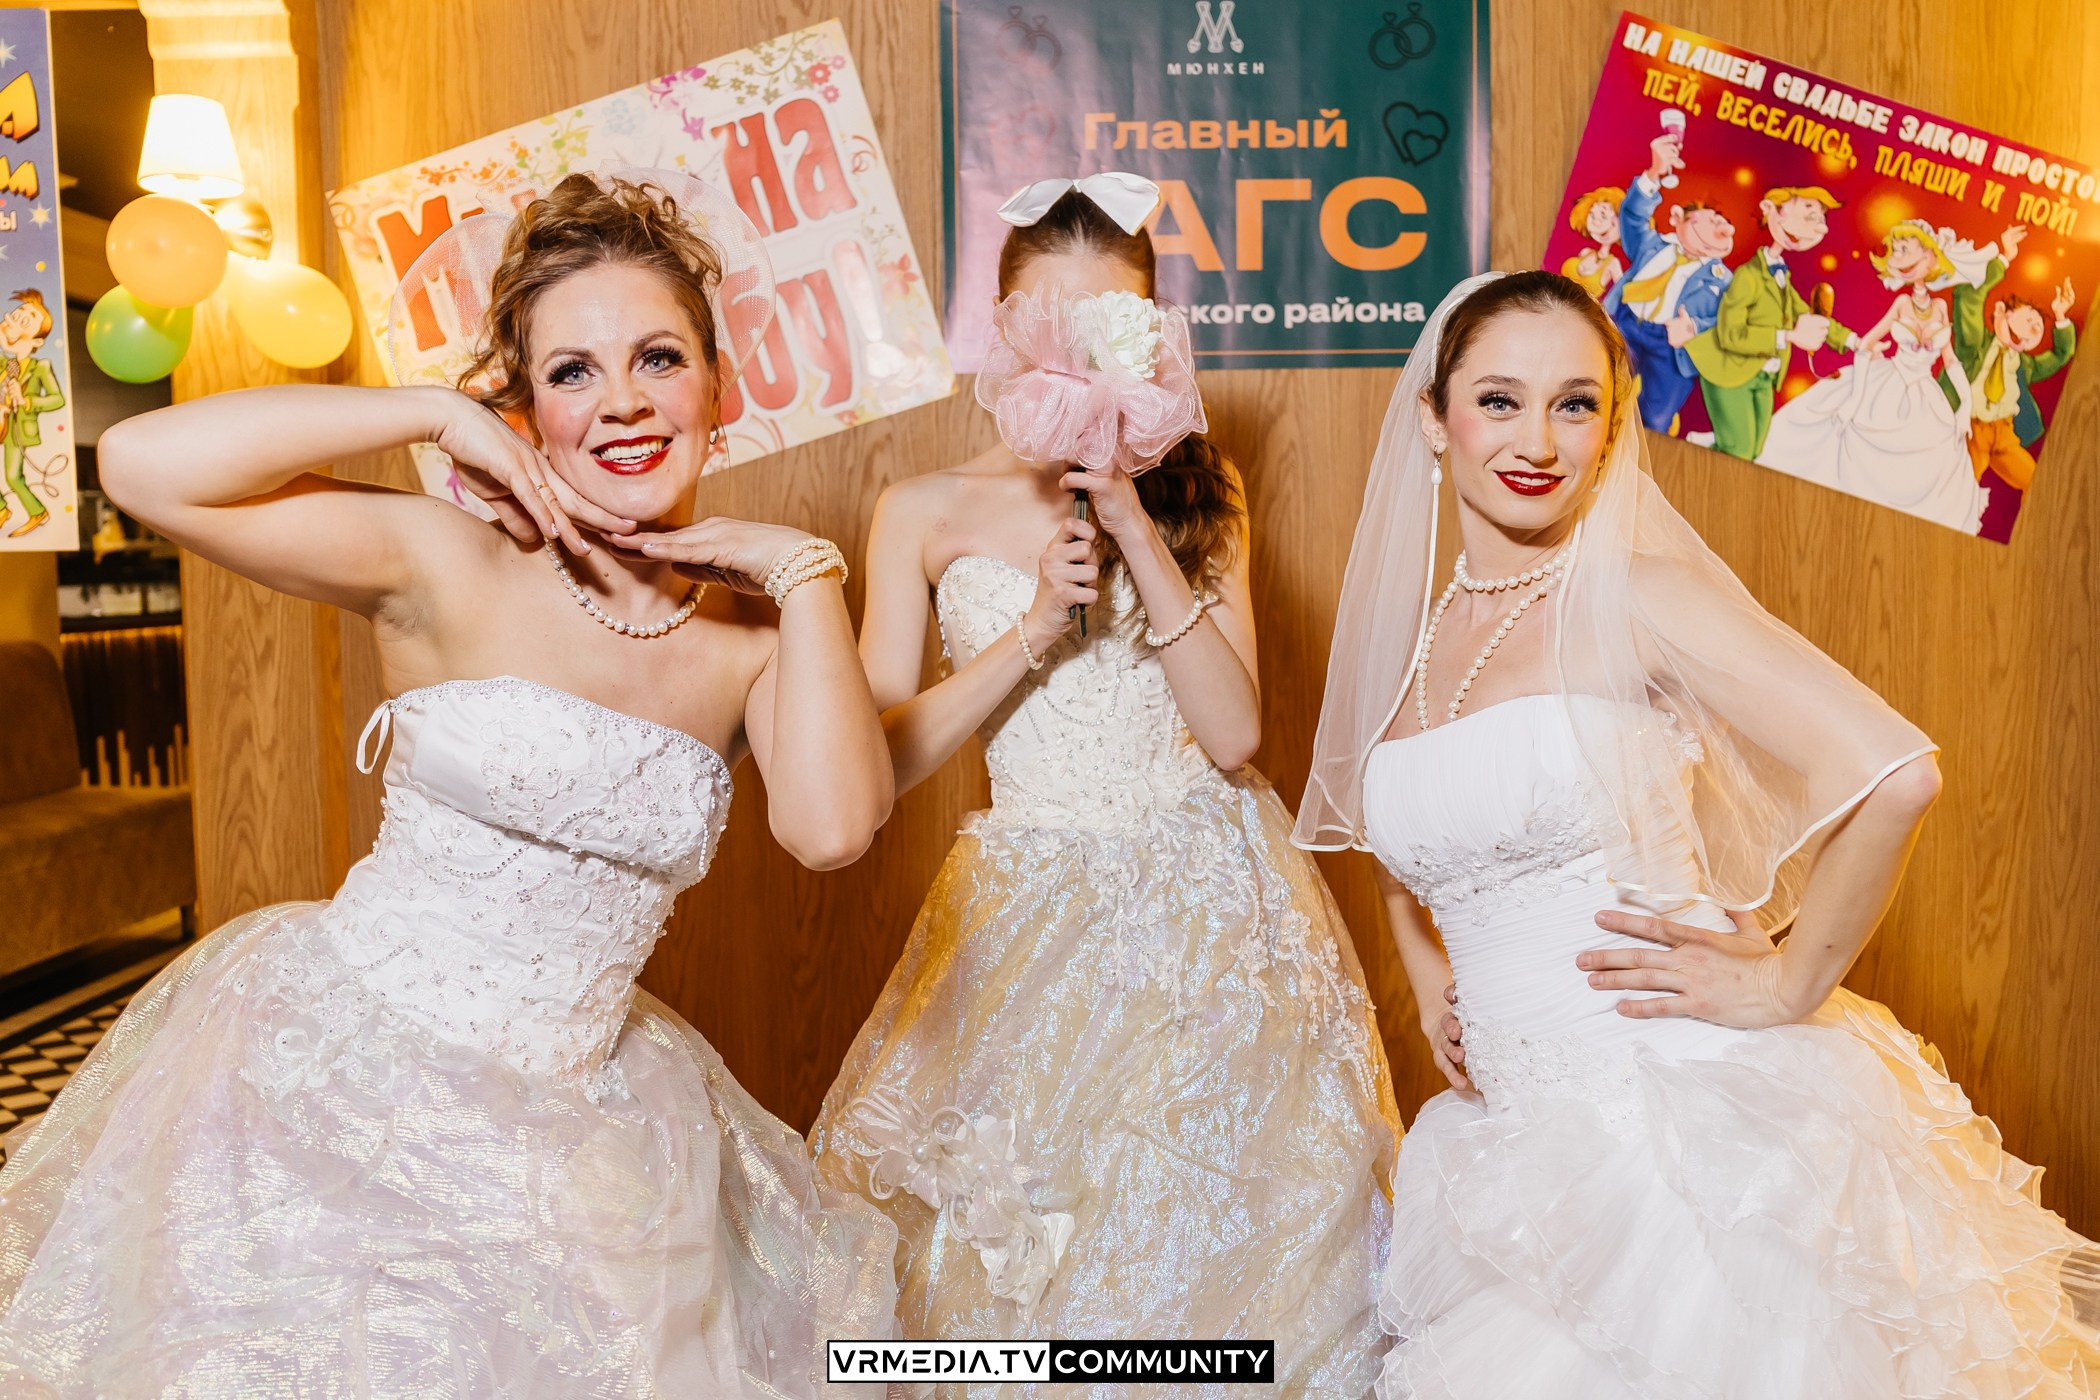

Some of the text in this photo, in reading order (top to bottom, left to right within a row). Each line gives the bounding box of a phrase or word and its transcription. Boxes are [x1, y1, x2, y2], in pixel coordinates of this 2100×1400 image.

[1167, 62, 1265, 75] МЮНХЕН
[1622, 22, 2100, 203] НА НАШЕЙ СВАДЬБЕ ЗАКОН ПРОСТО
[711, 97, 858, 237] на
[1083, 108, 1348, 150] Главный
[1642, 67, 2079, 236] ПЕЙ, ВЕСЕЛИСЬ, ПЛЯШИ И ПОЙ!
[1150, 176, 1428, 271] АГС
[1284, 296, 1427, 329] района
